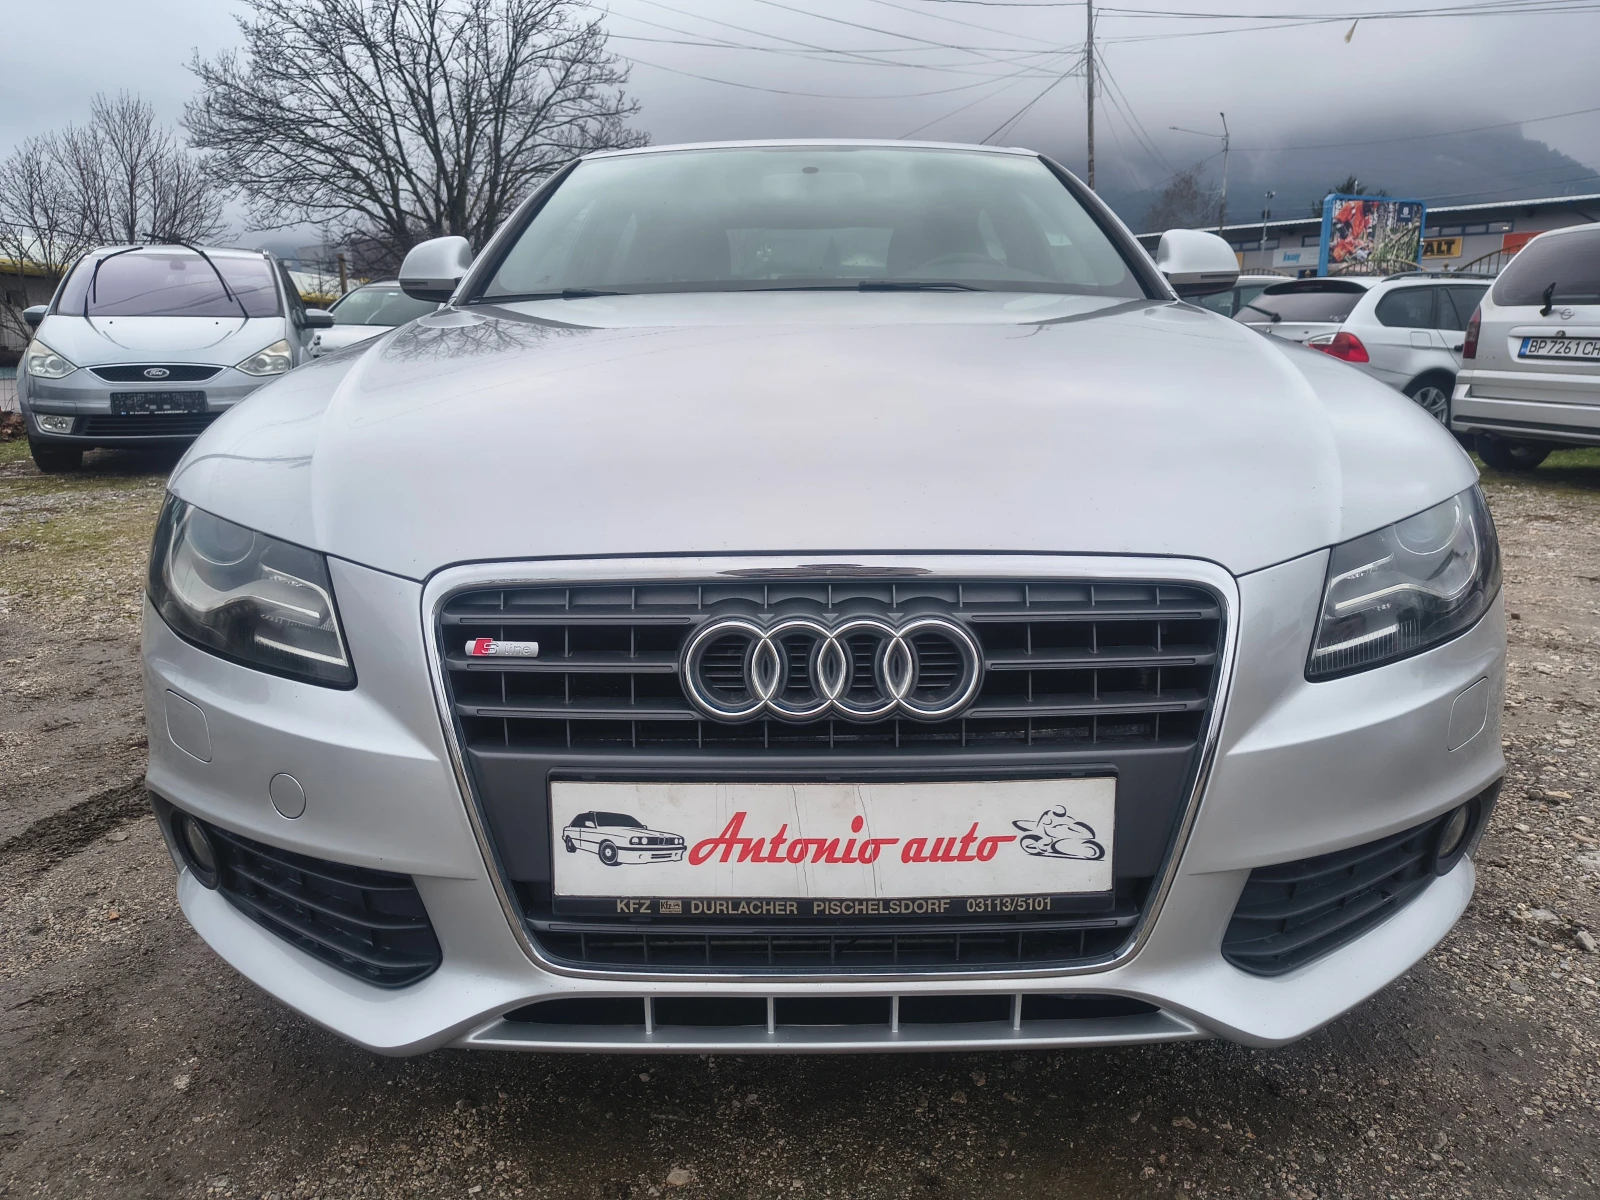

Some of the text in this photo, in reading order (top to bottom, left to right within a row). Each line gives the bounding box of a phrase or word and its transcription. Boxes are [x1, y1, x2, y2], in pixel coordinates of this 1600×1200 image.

[1423, 241, 1455, 255] ALT
[1529, 341, 1547, 353] BP
[1547, 341, 1580, 355] 7261
[1582, 341, 1600, 356] CH
[505, 643, 531, 655] line
[688, 811, 1017, 866] Antonio auto
[616, 899, 651, 913] KFZ
[691, 901, 798, 915] DURLACHER
[813, 900, 950, 915] PISCHELSDORF
[966, 896, 1052, 912] 03113/5101
